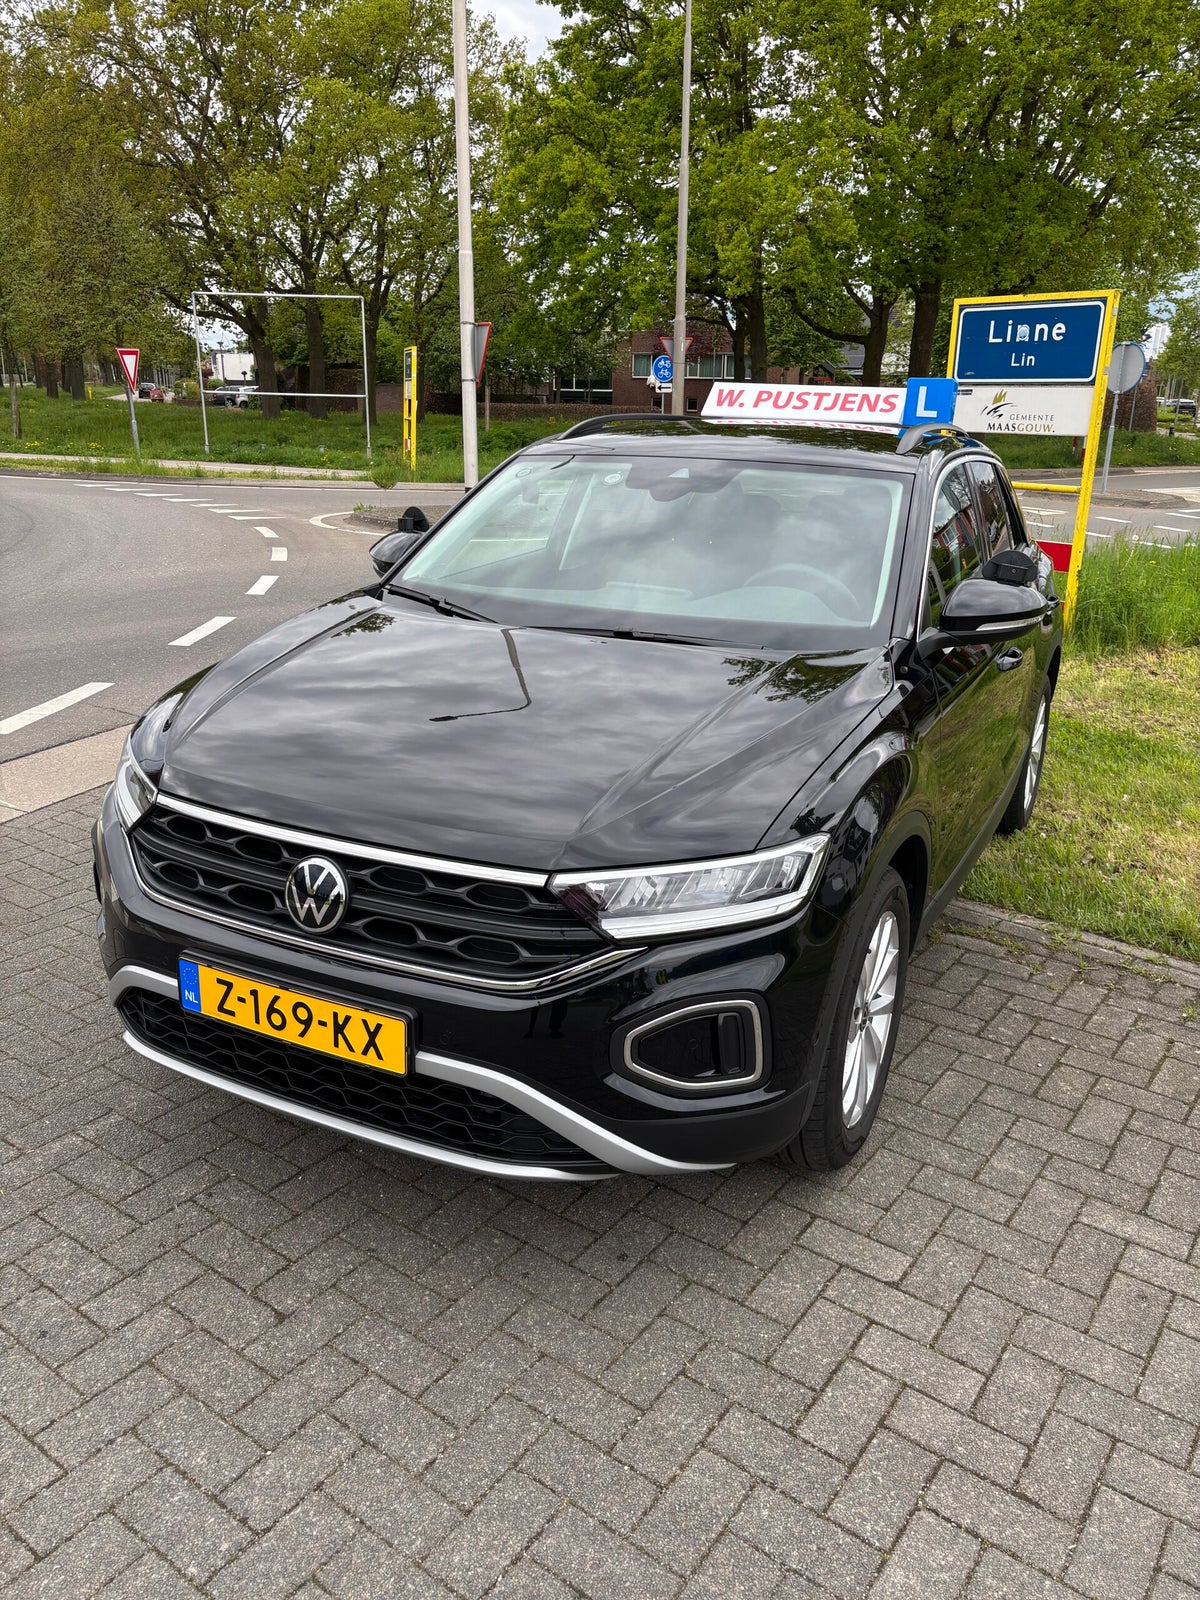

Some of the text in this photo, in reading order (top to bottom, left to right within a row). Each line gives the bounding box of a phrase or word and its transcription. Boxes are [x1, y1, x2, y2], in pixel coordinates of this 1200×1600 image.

[1011, 353, 1035, 367] Lin
[716, 389, 899, 413] W. PUSTJENS
[916, 386, 938, 418] L
[1009, 413, 1055, 421] GEMEENTE
[185, 989, 199, 1004] NL
[216, 978, 384, 1061] Z-169-KX
